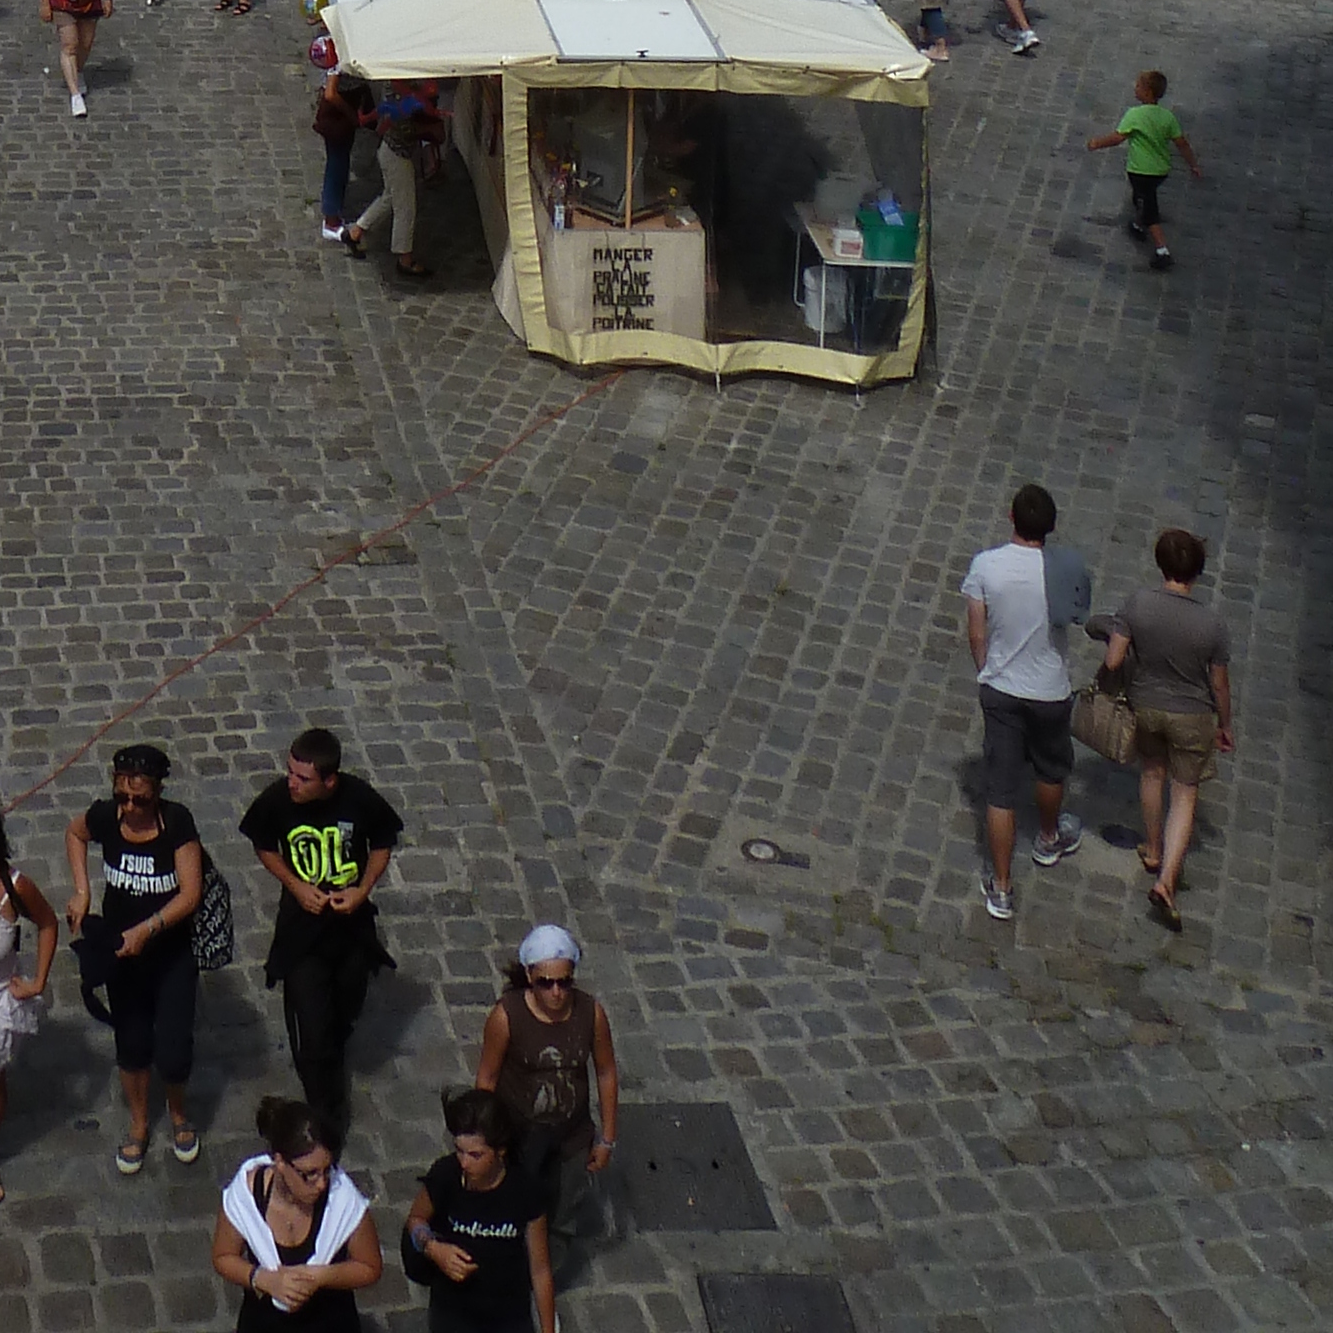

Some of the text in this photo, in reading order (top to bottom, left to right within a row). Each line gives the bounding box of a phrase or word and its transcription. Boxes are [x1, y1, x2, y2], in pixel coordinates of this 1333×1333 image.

[593, 248, 653, 262] MANGER
[593, 270, 651, 286] PRALINE
[592, 317, 655, 331] POITRINE
